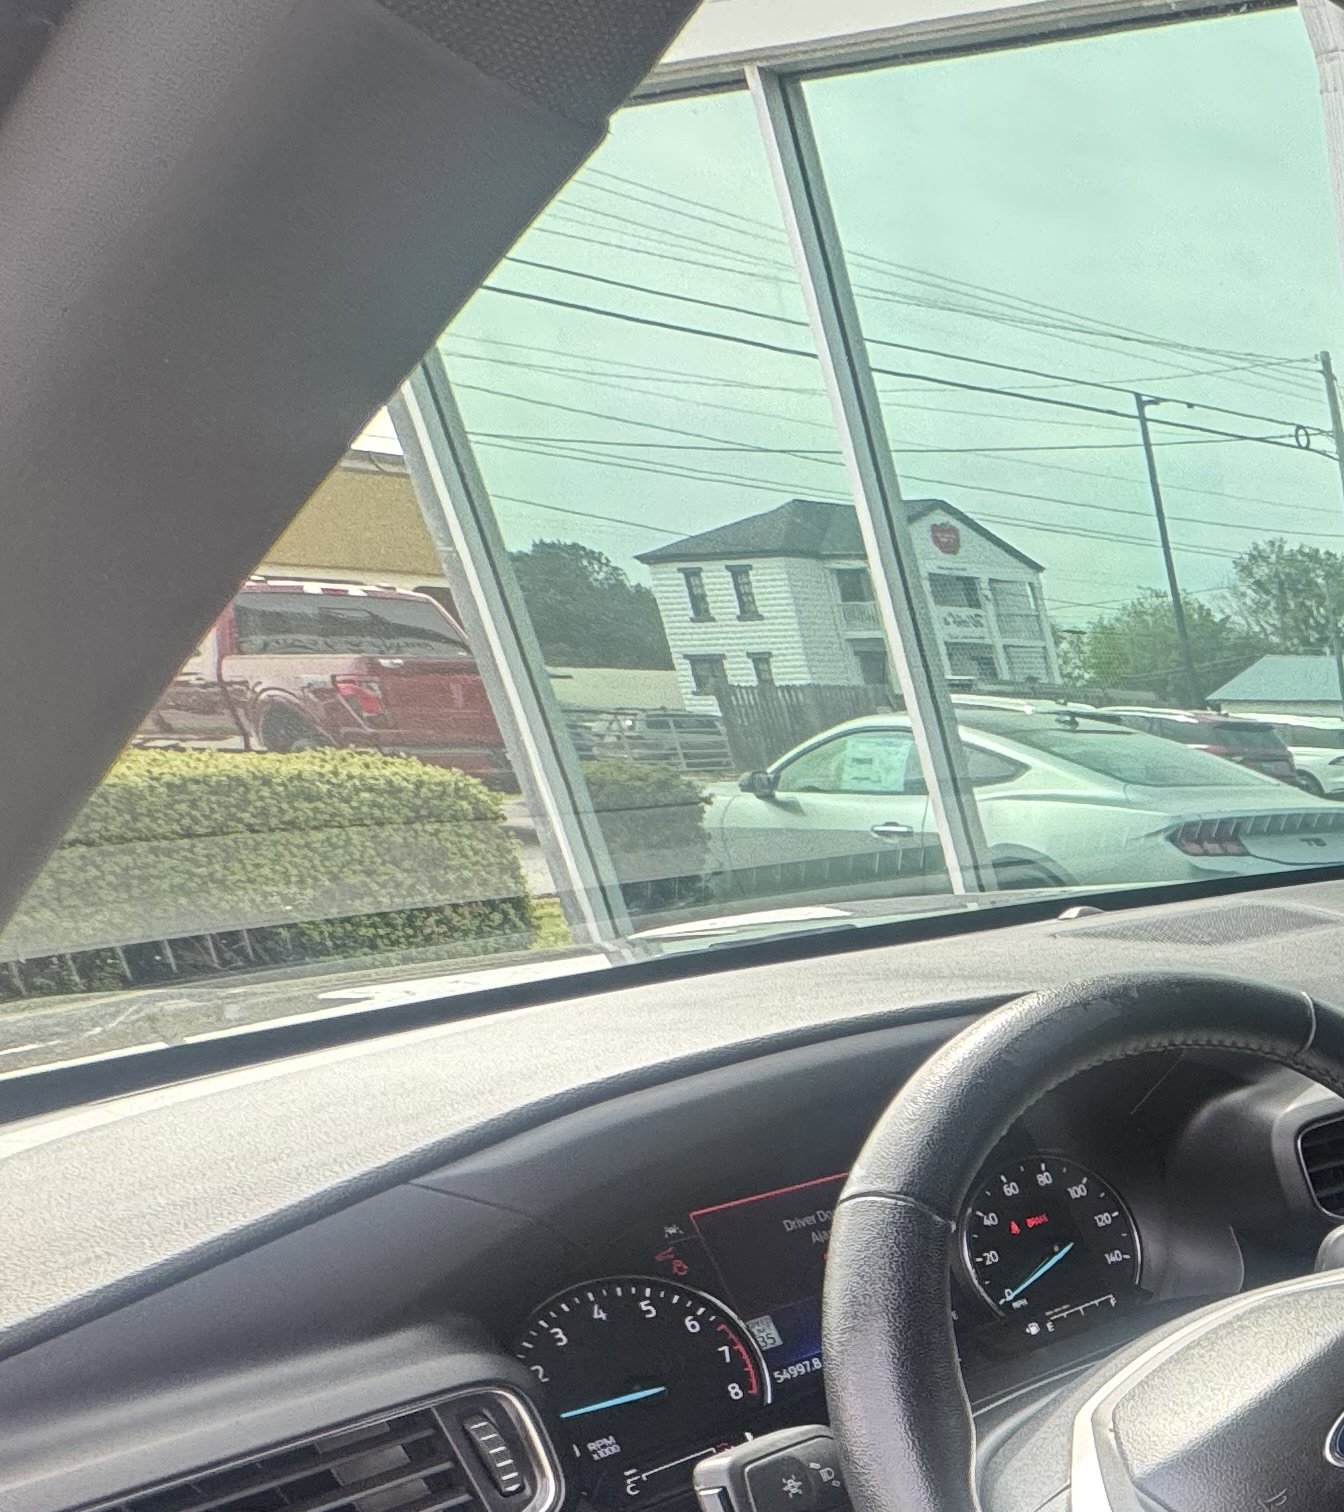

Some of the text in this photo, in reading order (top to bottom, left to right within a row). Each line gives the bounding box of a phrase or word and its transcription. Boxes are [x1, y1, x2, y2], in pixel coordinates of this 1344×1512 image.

[1037, 1172, 1053, 1185] 80
[1003, 1182, 1019, 1196] 60
[1067, 1185, 1088, 1199] 100
[783, 1214, 817, 1232] Driver
[983, 1212, 998, 1226] 40
[1094, 1214, 1111, 1227] 120
[983, 1251, 999, 1265] 20
[592, 1305, 607, 1320] 4
[638, 1300, 656, 1318] 5
[685, 1316, 700, 1333] 6
[550, 1328, 568, 1346] 3
[718, 1345, 731, 1363] 7
[531, 1365, 550, 1382] 2
[728, 1382, 743, 1399] 8
[587, 1435, 616, 1452] RPM
